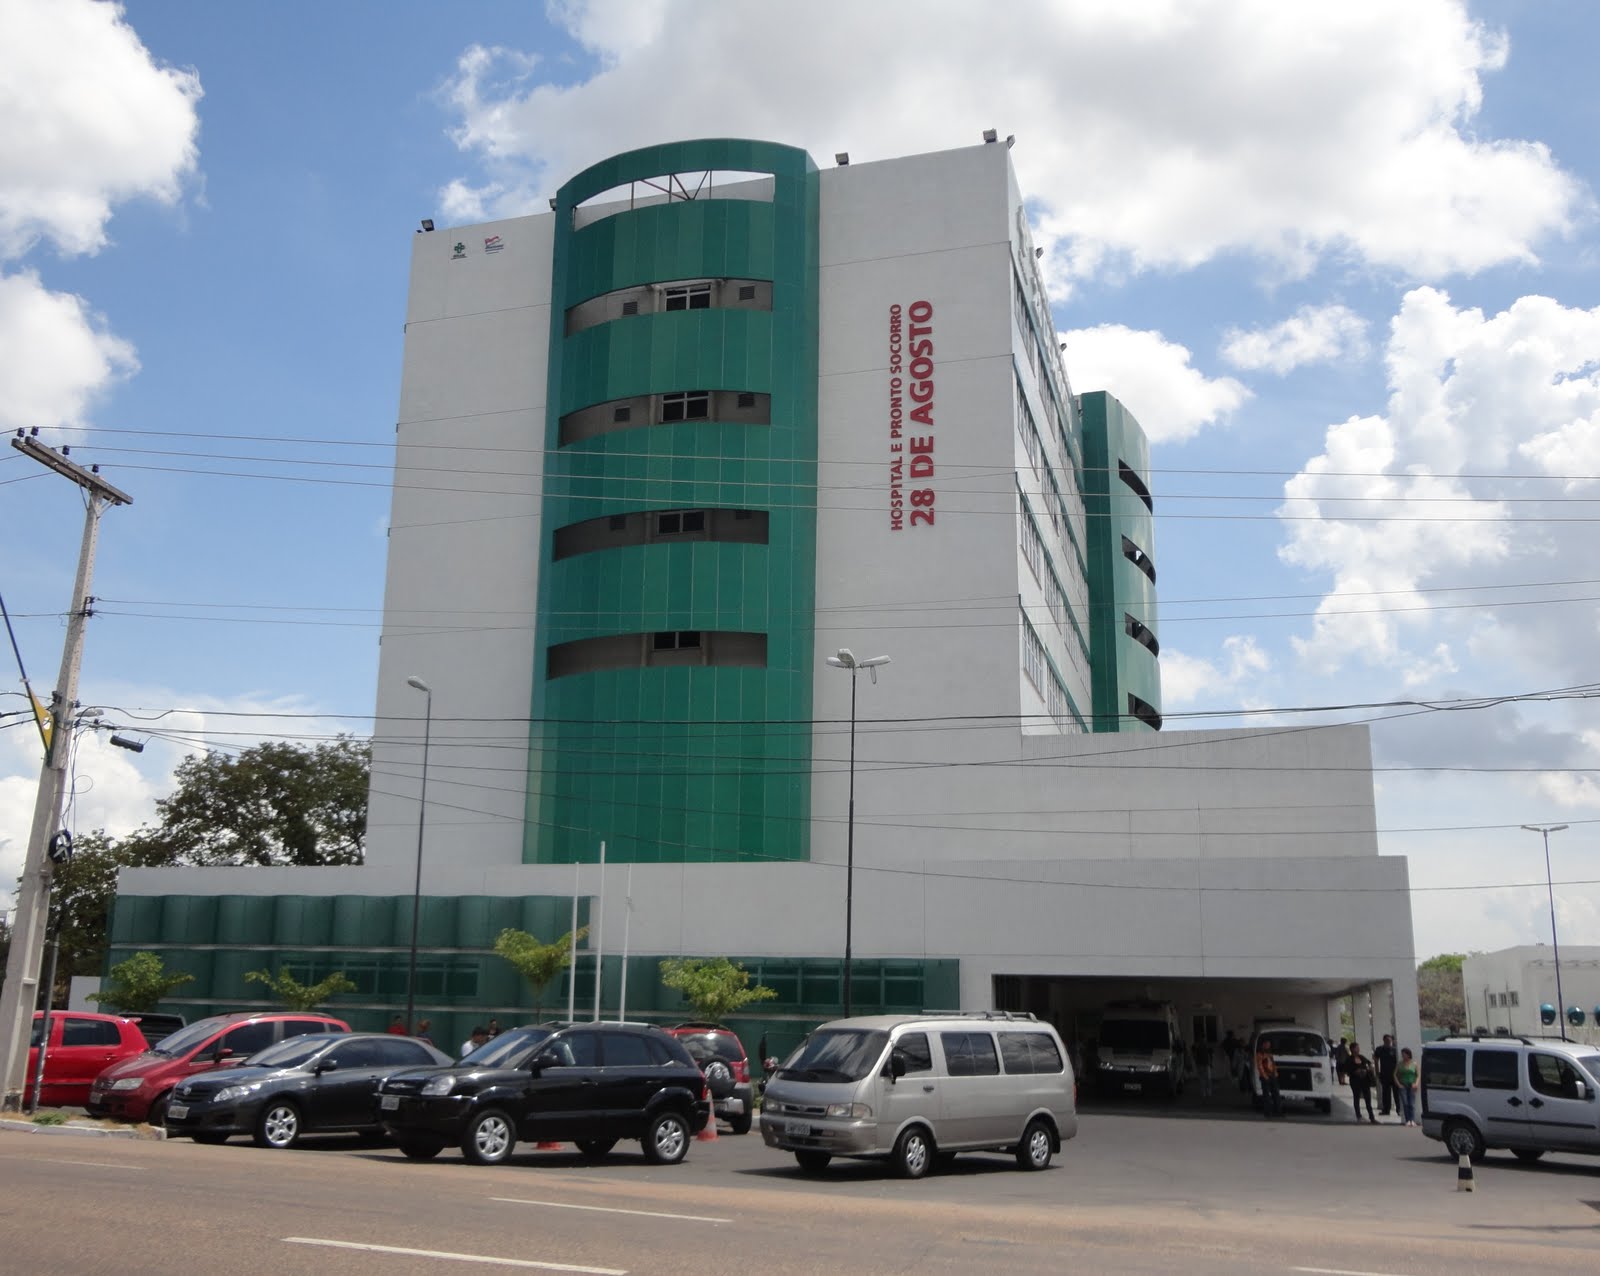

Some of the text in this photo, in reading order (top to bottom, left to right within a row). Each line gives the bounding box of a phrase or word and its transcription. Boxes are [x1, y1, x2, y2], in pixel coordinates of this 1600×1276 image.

[890, 304, 903, 531] HOSPITAL E PRONTO SOCORRO
[909, 300, 935, 526] 28 DE AGOSTO
